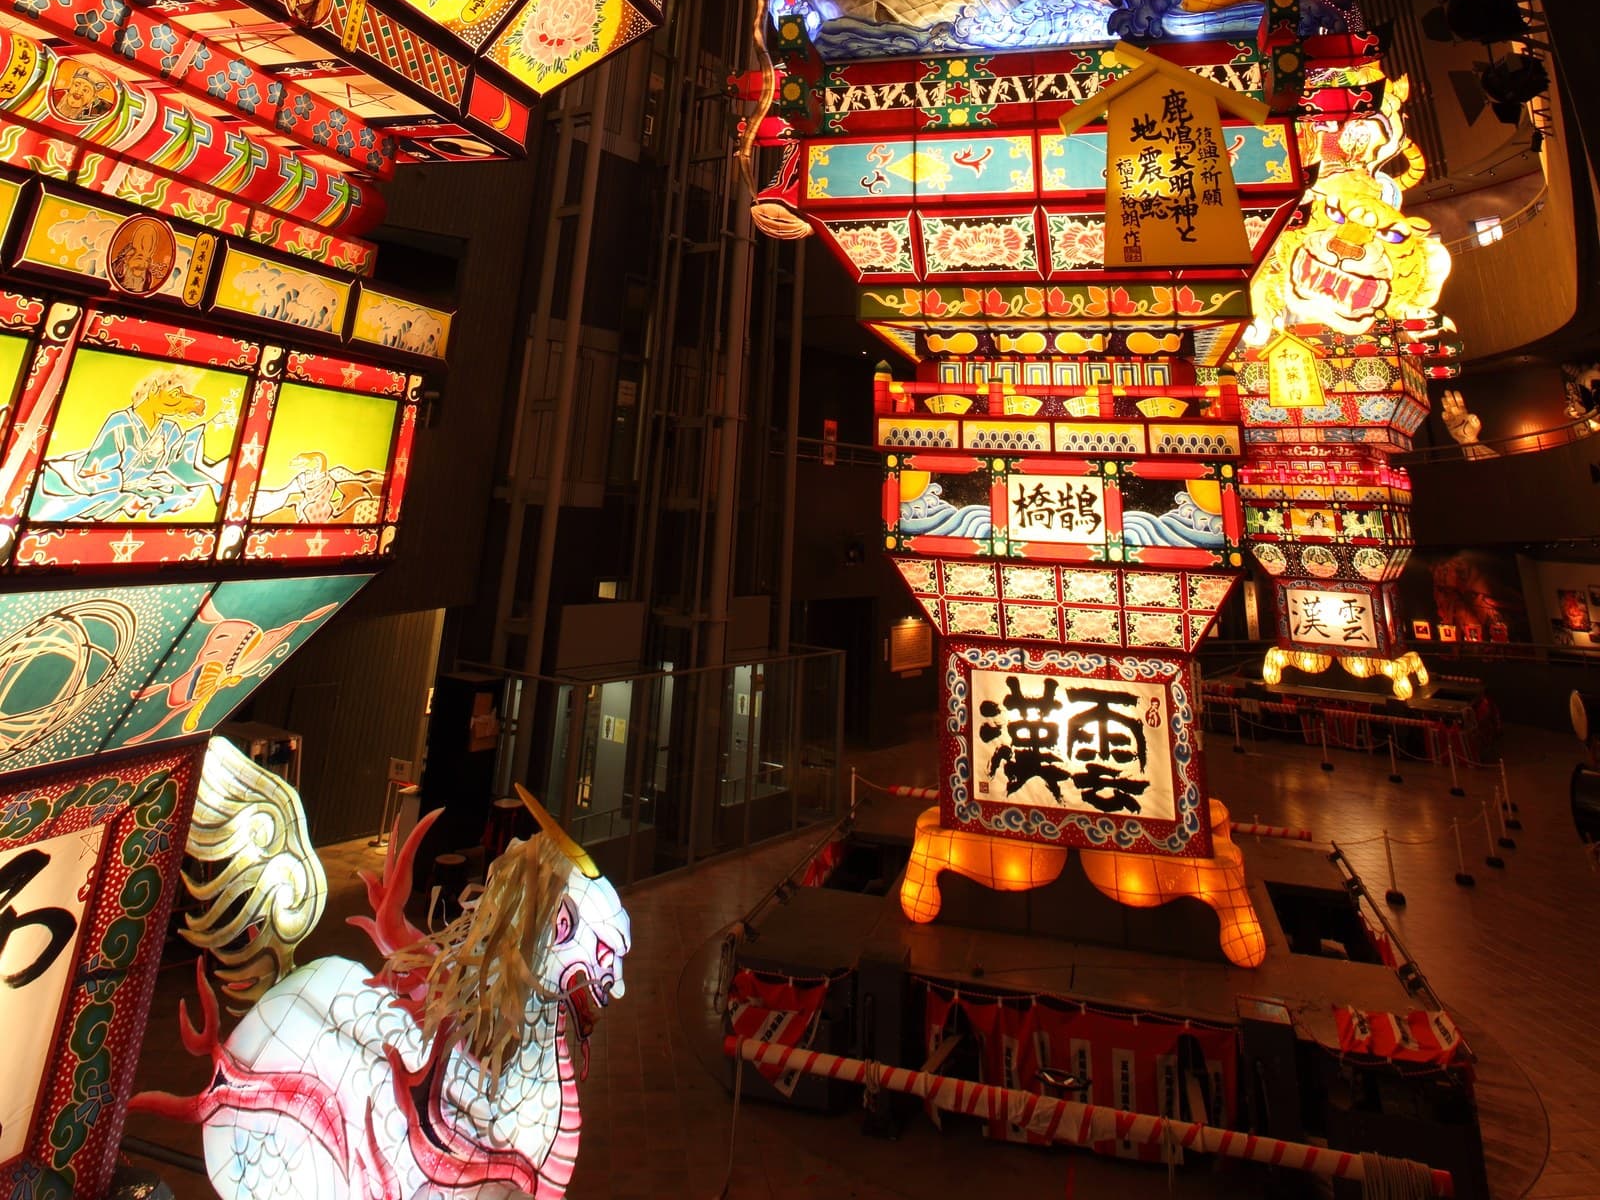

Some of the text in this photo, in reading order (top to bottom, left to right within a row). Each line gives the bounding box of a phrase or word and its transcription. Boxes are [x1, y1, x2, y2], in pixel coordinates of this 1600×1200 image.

[1130, 113, 1169, 220] 地震鯰
[1161, 88, 1199, 243] 鹿嶋大明神と
[1196, 127, 1223, 207] 復興祈願
